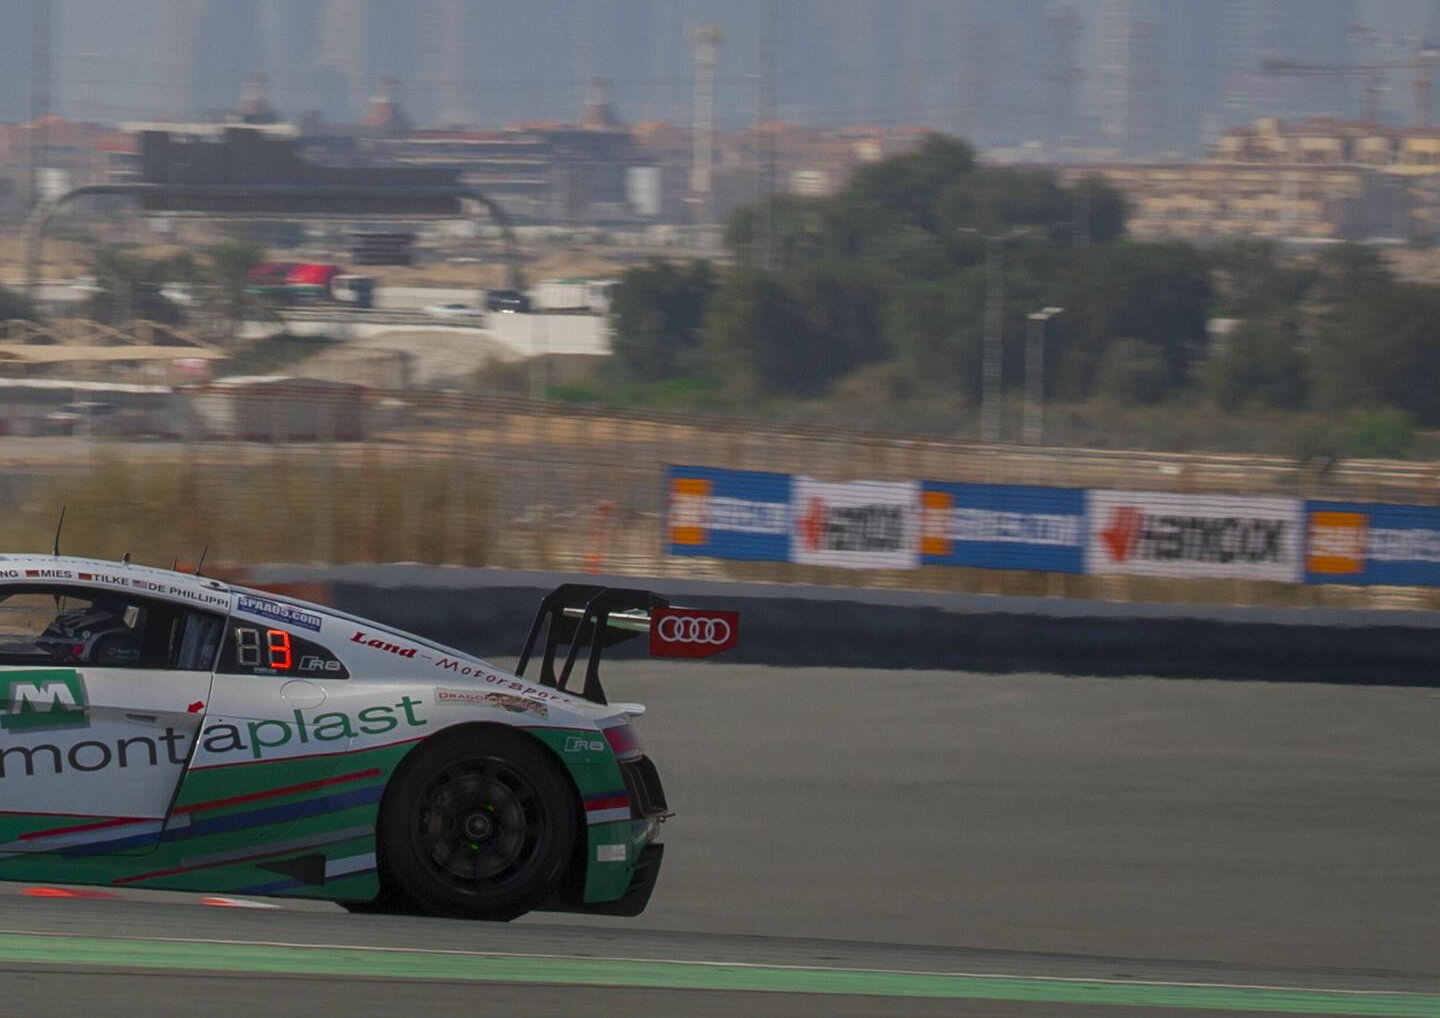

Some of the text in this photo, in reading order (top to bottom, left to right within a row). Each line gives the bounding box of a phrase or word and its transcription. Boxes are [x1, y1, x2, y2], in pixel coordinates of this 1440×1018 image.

[41, 569, 72, 579] MIES
[92, 574, 129, 586] TILKE
[148, 582, 229, 608] DE PHILLIPPI
[350, 631, 418, 659] Land
[305, 658, 341, 671] R8
[570, 738, 604, 752] R8
